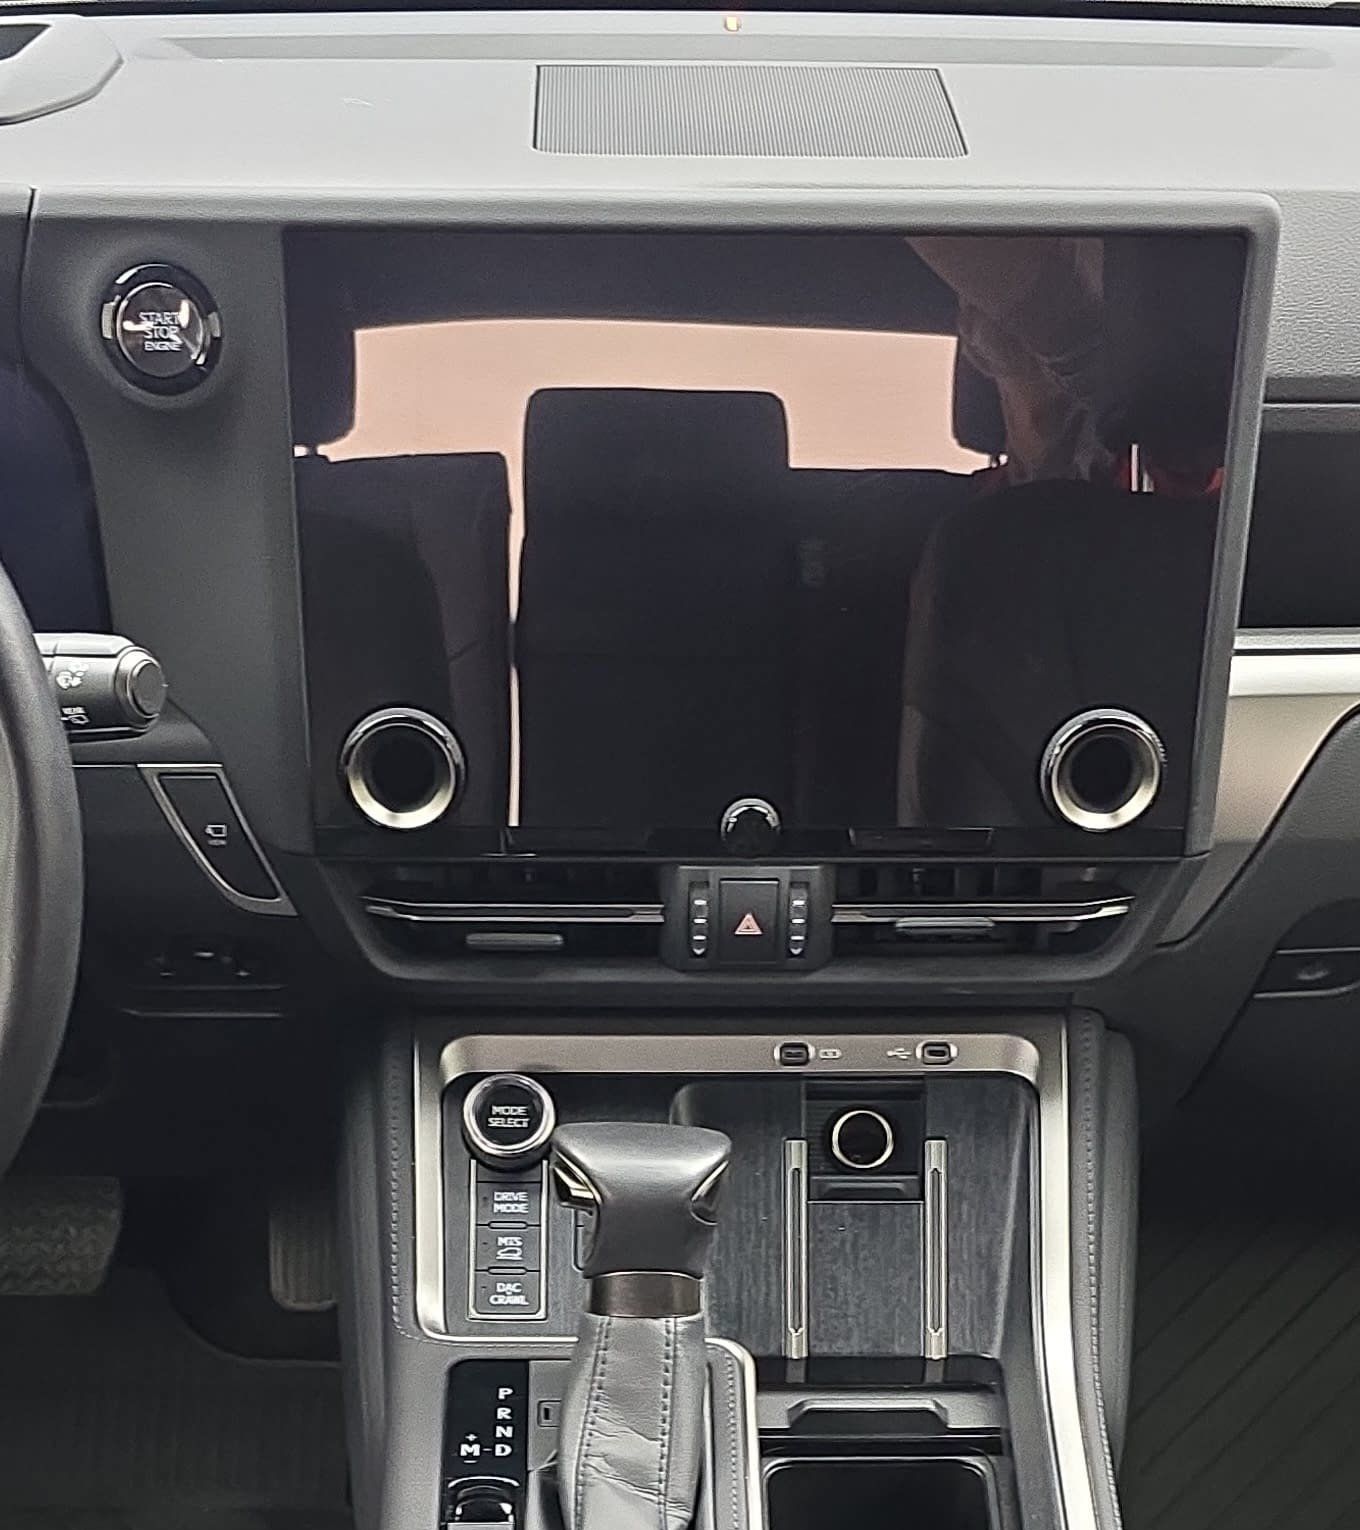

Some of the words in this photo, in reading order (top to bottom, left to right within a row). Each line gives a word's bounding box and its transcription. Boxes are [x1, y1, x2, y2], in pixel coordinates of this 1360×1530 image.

[139, 311, 179, 325] START
[143, 325, 179, 339] STOP
[144, 341, 182, 351] ENGINE
[492, 1105, 528, 1116] MODE
[487, 1117, 530, 1128] SELECT
[493, 1191, 529, 1202] DRIVE
[493, 1202, 529, 1214] MODE
[497, 1236, 523, 1247] MTS
[496, 1282, 522, 1293] DAC
[489, 1294, 529, 1306] CRAWL
[498, 1387, 514, 1400] P
[496, 1407, 513, 1420] R
[495, 1425, 514, 1438] N
[460, 1443, 481, 1457] M
[494, 1443, 513, 1457] D
